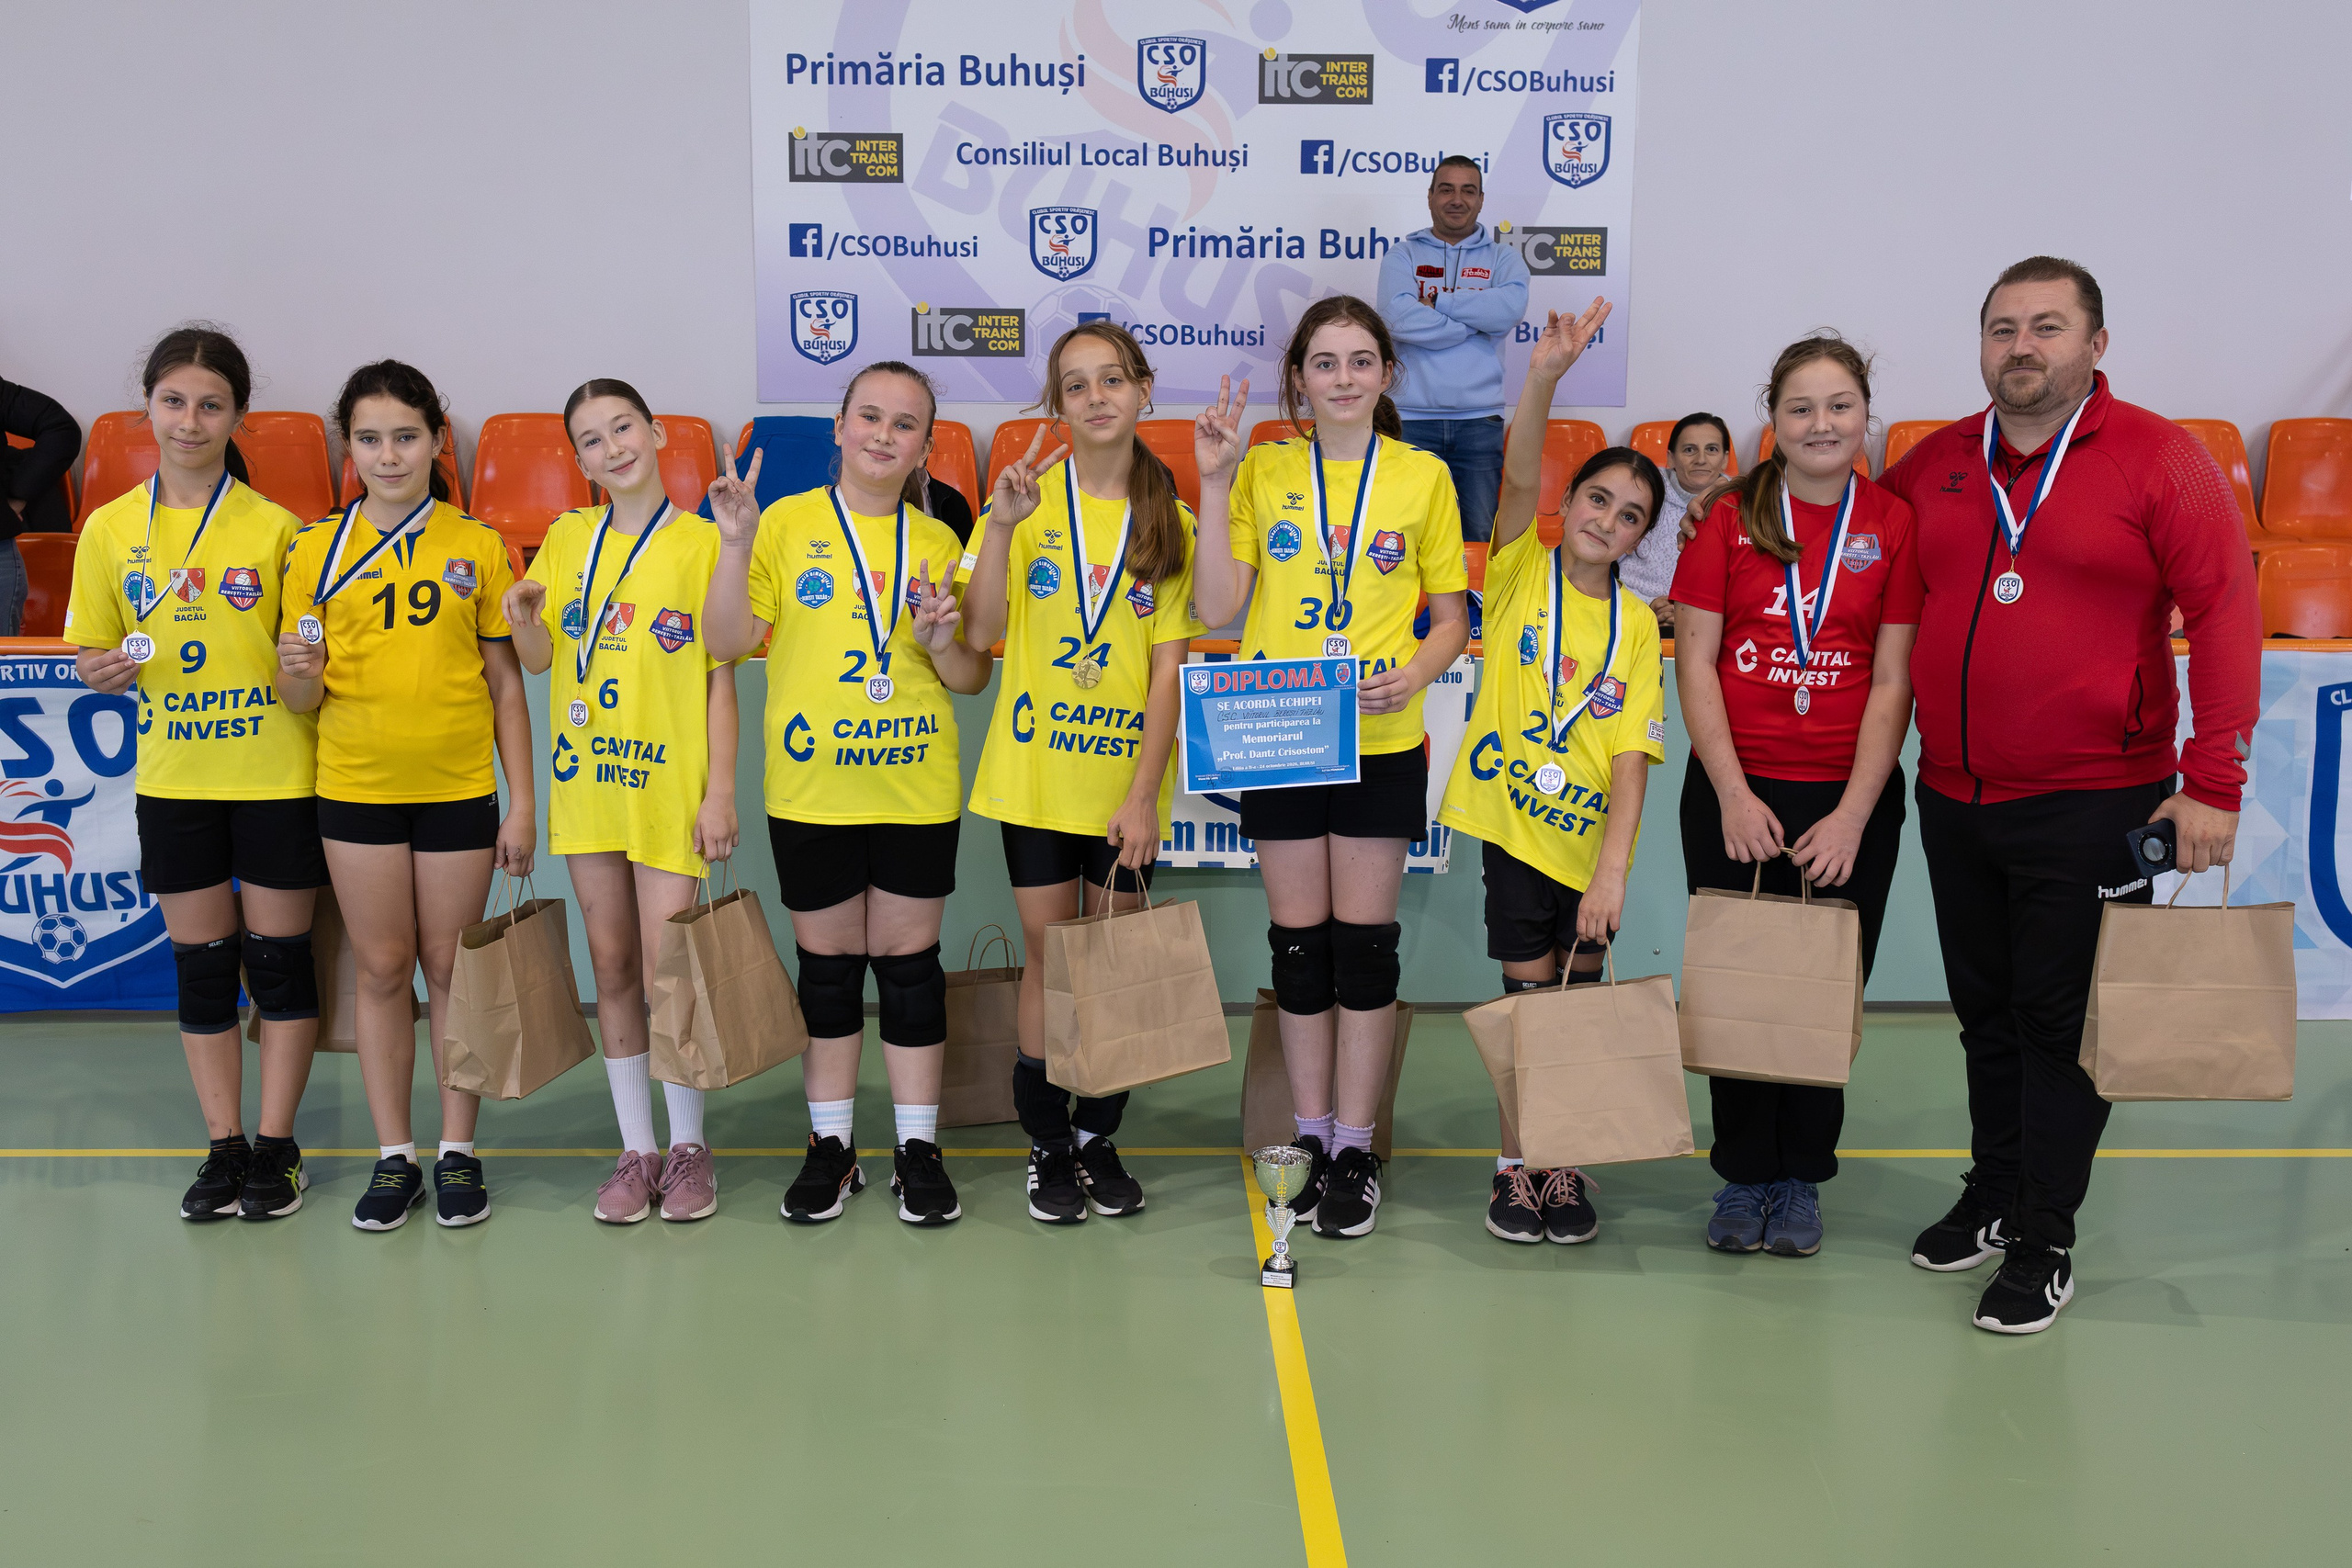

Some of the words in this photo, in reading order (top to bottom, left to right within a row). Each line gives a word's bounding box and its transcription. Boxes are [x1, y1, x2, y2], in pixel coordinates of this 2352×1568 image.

[1447, 13, 1480, 33] Mens
[1484, 19, 1511, 31] sana
[1515, 19, 1527, 30] in
[1531, 20, 1574, 34] corpore
[1577, 20, 1605, 31] sano
[1147, 45, 1197, 65] CSO
[786, 51, 944, 85] Primăria
[960, 53, 1085, 95] Buhuși
[1264, 48, 1323, 97] itc
[1326, 62, 1368, 73] INTER
[1320, 74, 1368, 85] TRANS
[1463, 67, 1615, 96] /CSOBuhusi
[1335, 86, 1368, 98] COM
[1553, 121, 1602, 141] CSO
[794, 126, 853, 176] itc
[855, 141, 898, 152] INTER
[850, 152, 898, 164] TRANS
[956, 141, 1070, 165] Consiliul
[1080, 142, 1148, 165] Local
[1158, 143, 1249, 173] Buhuși
[865, 165, 899, 176] COM
[1038, 215, 1088, 235] CSO
[826, 232, 978, 260] /CSOBuhusi
[1148, 226, 1306, 260] Primăria
[1560, 234, 1601, 245] INTER
[1554, 246, 1601, 257] TRANS
[1569, 258, 1601, 270] COM
[799, 299, 848, 319] CSO
[918, 301, 975, 351] itc
[978, 315, 1019, 326] INTER
[972, 327, 1019, 339] TRANS
[988, 339, 1019, 351] COM
[1038, 542, 1063, 551] hummel
[373, 580, 441, 629] 19
[1763, 583, 1820, 619] 14
[175, 613, 207, 622] BACĂU
[1295, 597, 1353, 632] 30
[180, 640, 207, 673] 9
[599, 642, 628, 652] BACĂU
[1051, 637, 1112, 670] 24
[1770, 647, 1852, 666] CAPITAL
[1213, 662, 1327, 693] DIPLOMĂ
[1767, 667, 1840, 686] INVEST
[164, 685, 277, 713] CAPITAL
[598, 678, 618, 709] 6
[1216, 701, 1231, 711] SE
[1233, 696, 1277, 710] ACORDĂ
[1280, 696, 1322, 708] ECHIPEI
[832, 714, 939, 739] CAPITAL
[1050, 702, 1144, 732] CAPITA
[1224, 721, 1253, 732] pentru
[1255, 718, 1310, 730] participarea
[167, 716, 264, 740] INVEST
[1242, 731, 1303, 744] Memoriarul
[591, 736, 666, 764] CAPITAL
[1048, 730, 1139, 758] INVEST
[835, 743, 929, 766] INVEST
[1249, 750, 1275, 759] Dantz
[596, 763, 650, 789] INVEST
[2098, 878, 2148, 898] hummel
